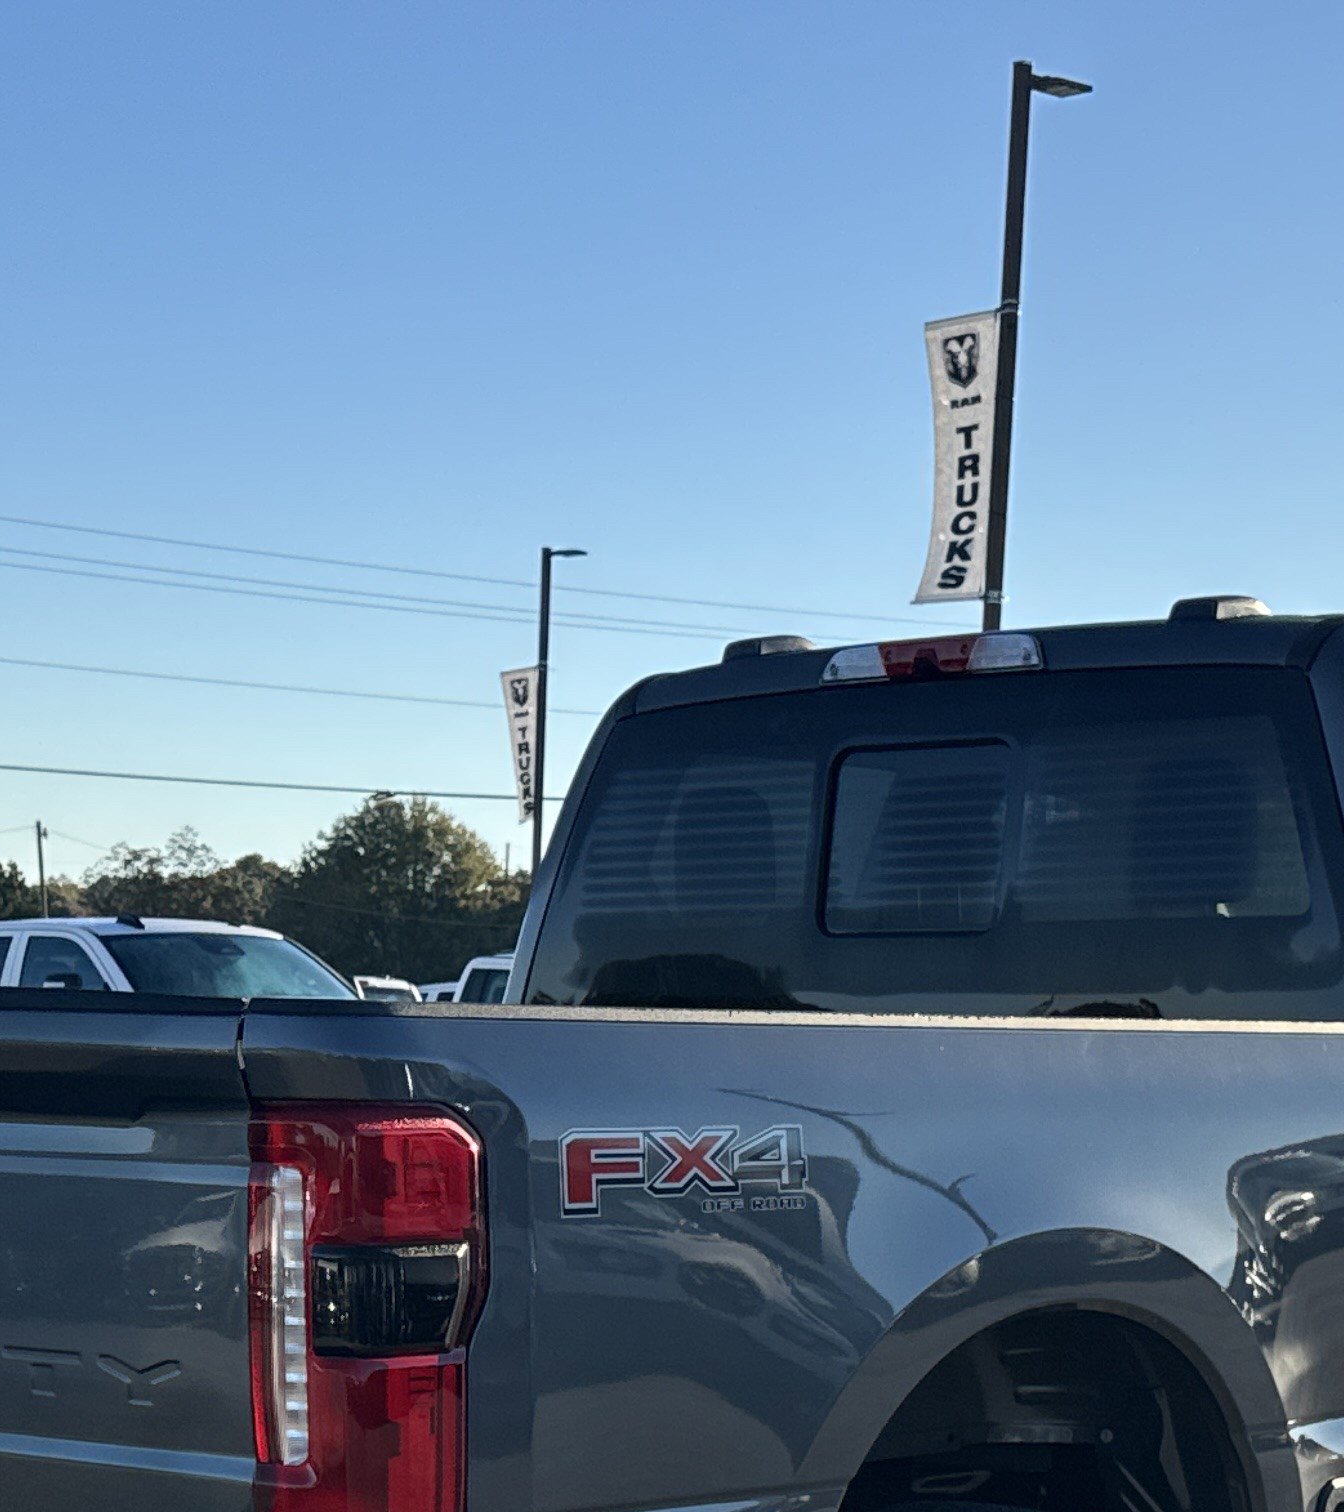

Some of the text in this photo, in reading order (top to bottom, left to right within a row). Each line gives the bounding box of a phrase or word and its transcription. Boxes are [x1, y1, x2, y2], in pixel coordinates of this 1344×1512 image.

[937, 424, 980, 590] TRUCKS
[517, 726, 535, 816] TRUCKS
[559, 1124, 809, 1218] FX4
[702, 1196, 807, 1214] OFF ROAD
